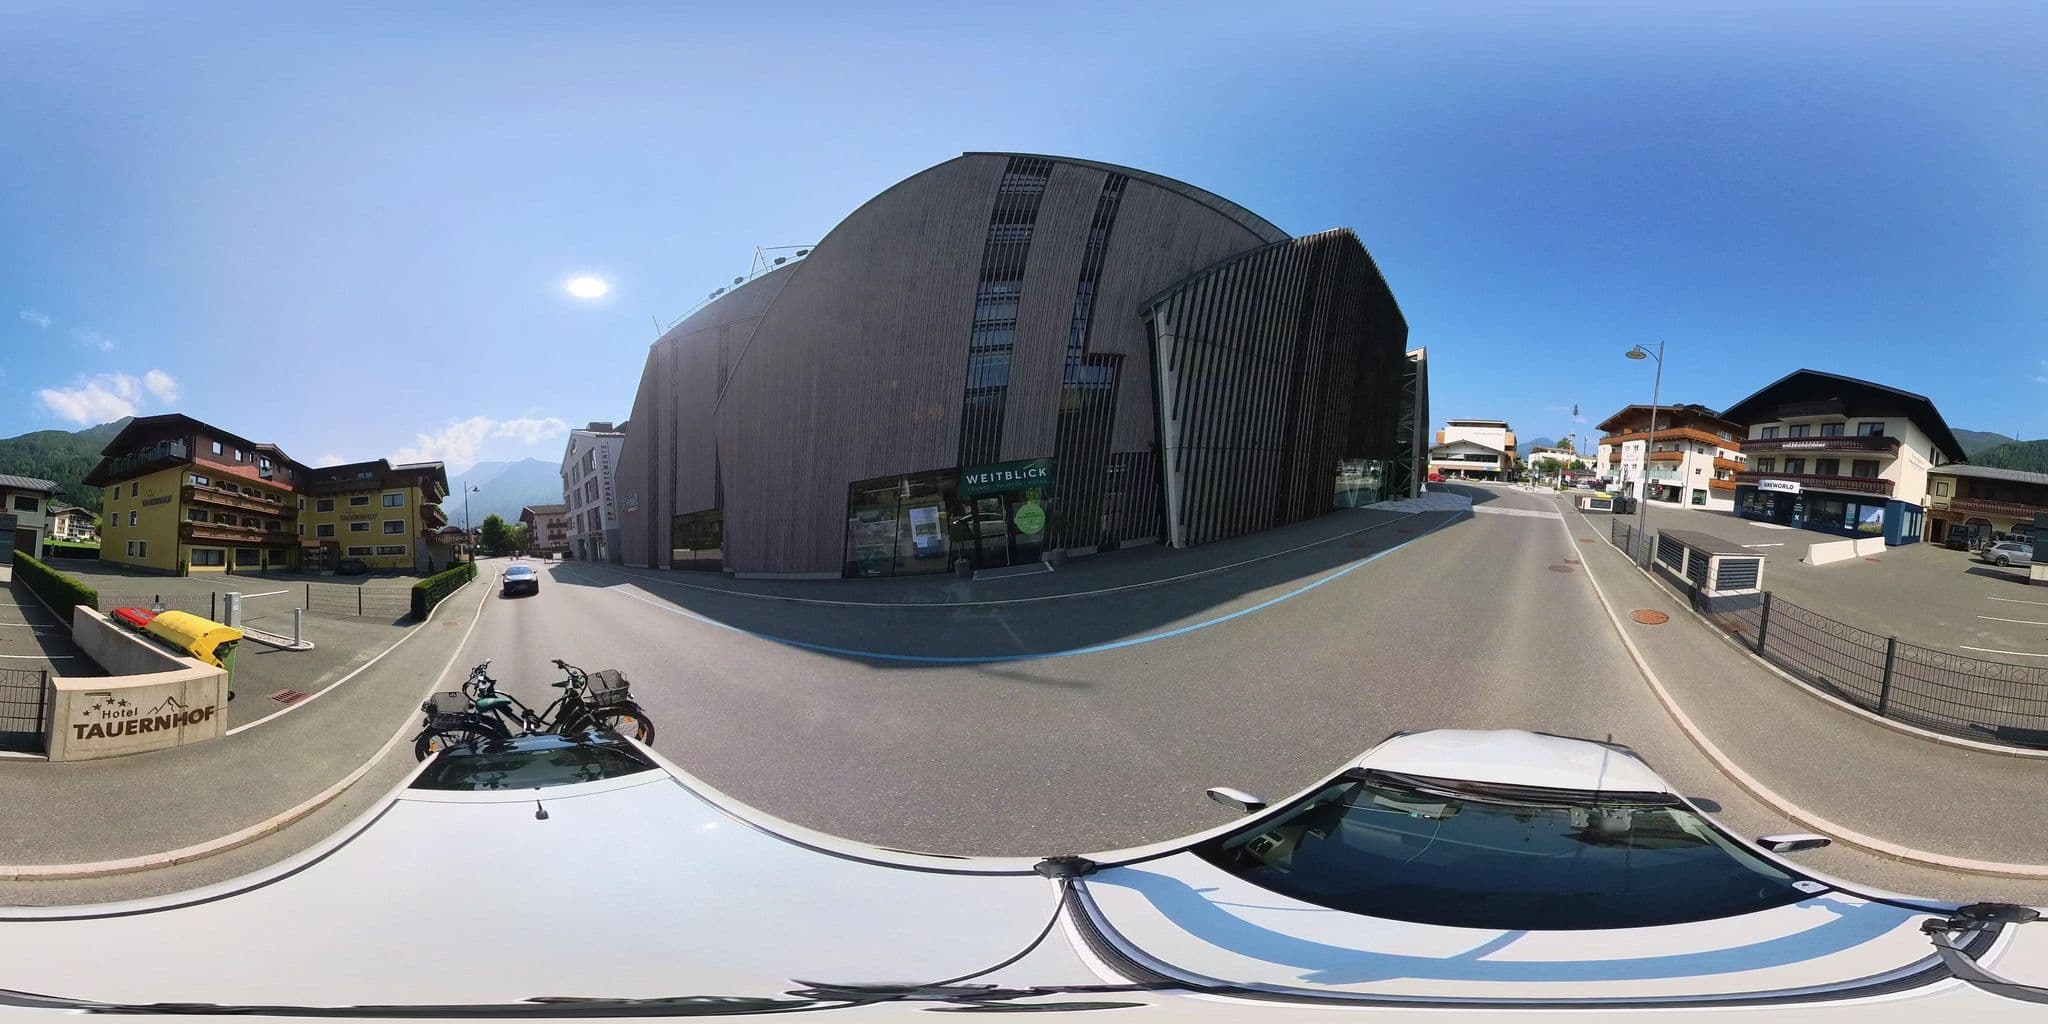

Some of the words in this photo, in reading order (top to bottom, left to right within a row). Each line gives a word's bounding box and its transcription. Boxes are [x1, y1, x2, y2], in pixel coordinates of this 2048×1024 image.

[601, 445, 612, 507] APPARTEMENTS
[73, 706, 215, 740] TAUERNHOF
[102, 707, 138, 719] Hotel
